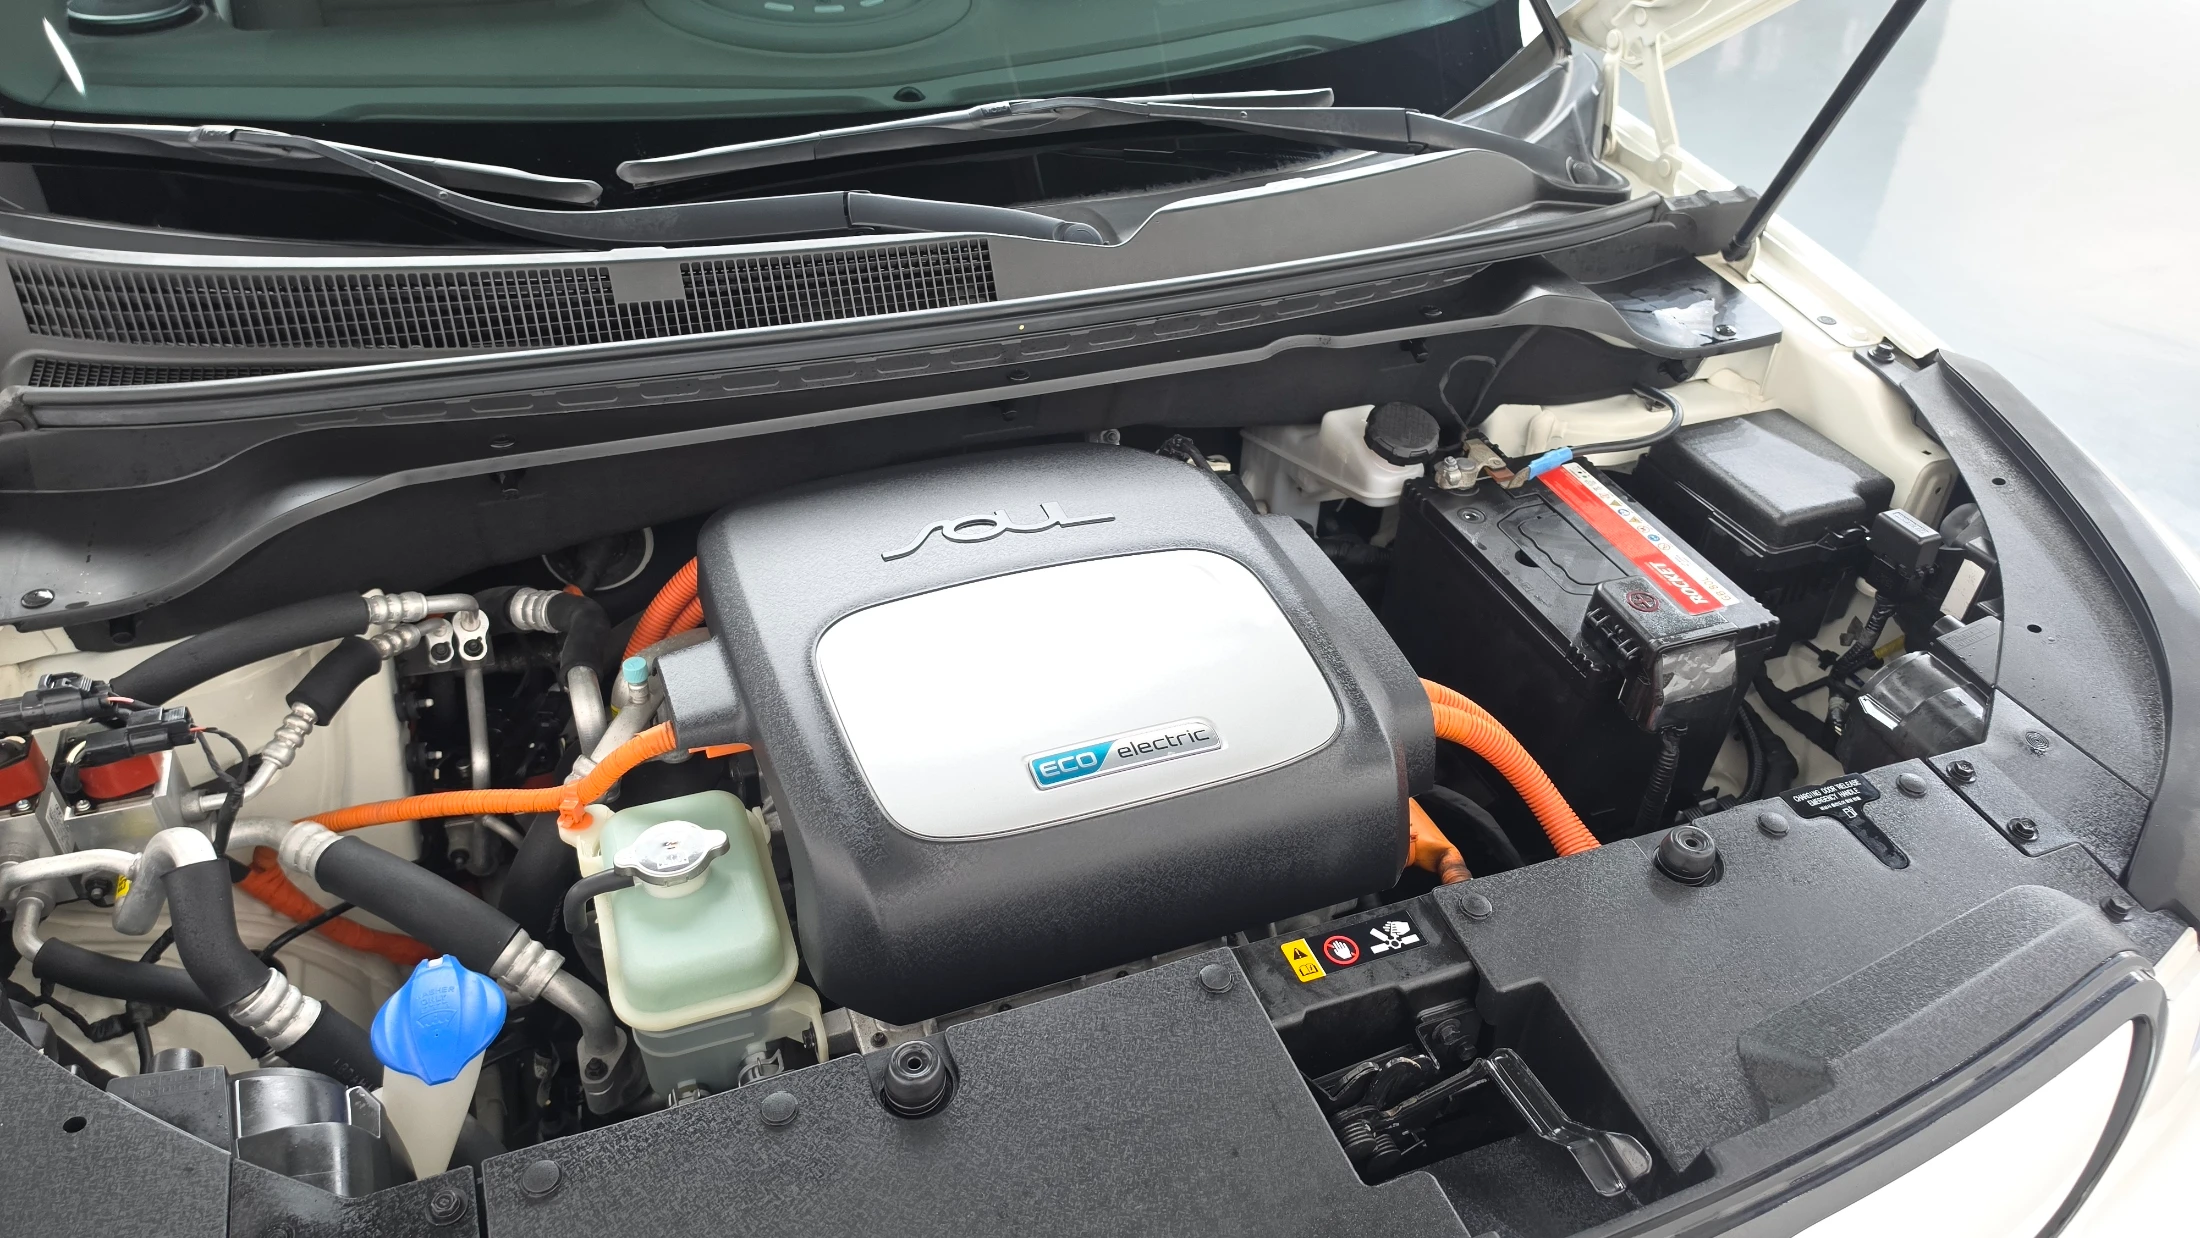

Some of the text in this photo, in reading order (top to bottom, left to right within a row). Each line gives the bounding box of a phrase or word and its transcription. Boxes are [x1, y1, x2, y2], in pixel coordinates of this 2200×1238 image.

[881, 501, 1116, 562] SOUL
[1649, 561, 1709, 605] ROCKET
[1039, 729, 1210, 778] ECO electric
[1807, 793, 1839, 807] EMERGENCY
[1837, 787, 1861, 799] HANDLE
[1834, 779, 1862, 790] RELEASE
[415, 986, 455, 1000] WASHER
